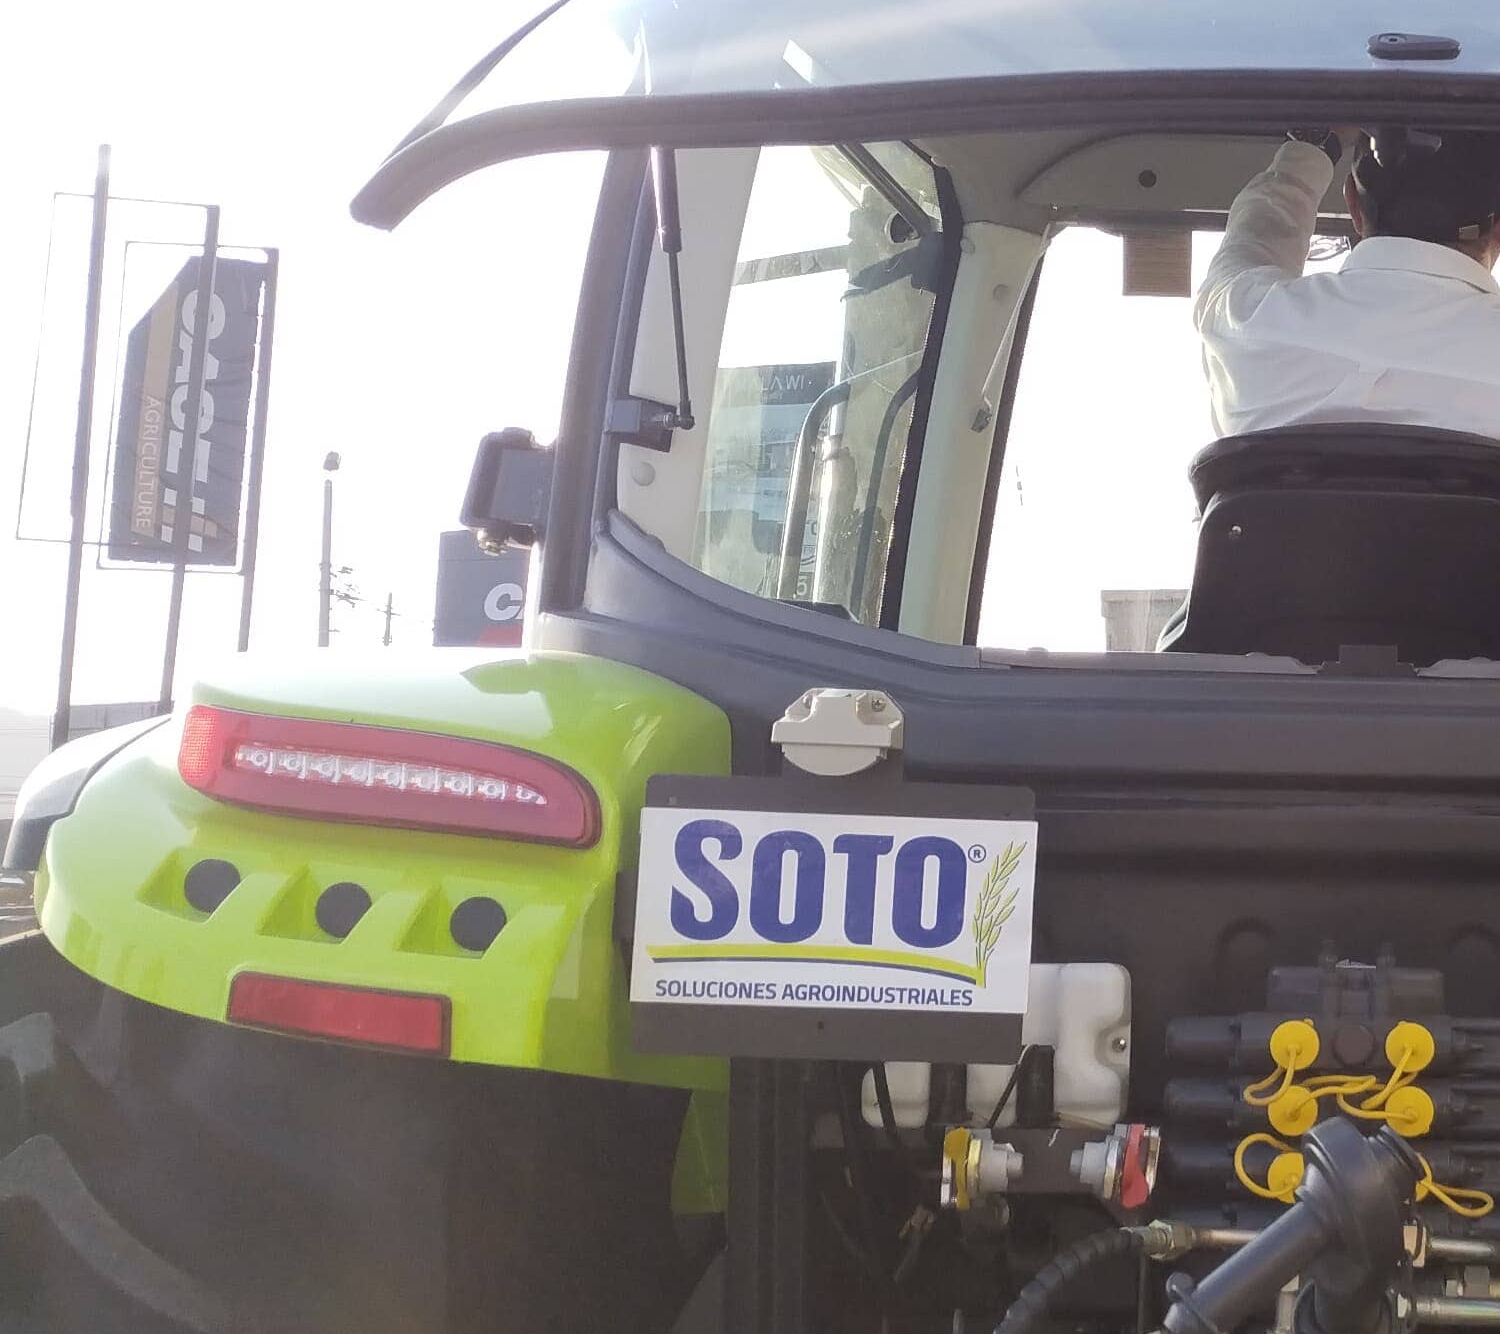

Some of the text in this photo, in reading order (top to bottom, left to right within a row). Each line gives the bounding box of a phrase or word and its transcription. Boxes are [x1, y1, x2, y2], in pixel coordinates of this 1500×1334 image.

[134, 394, 162, 529] AGRICULTURE
[483, 582, 525, 621] C
[655, 979, 974, 1008] SOLUCIONES AGROINDUSTRIALES
